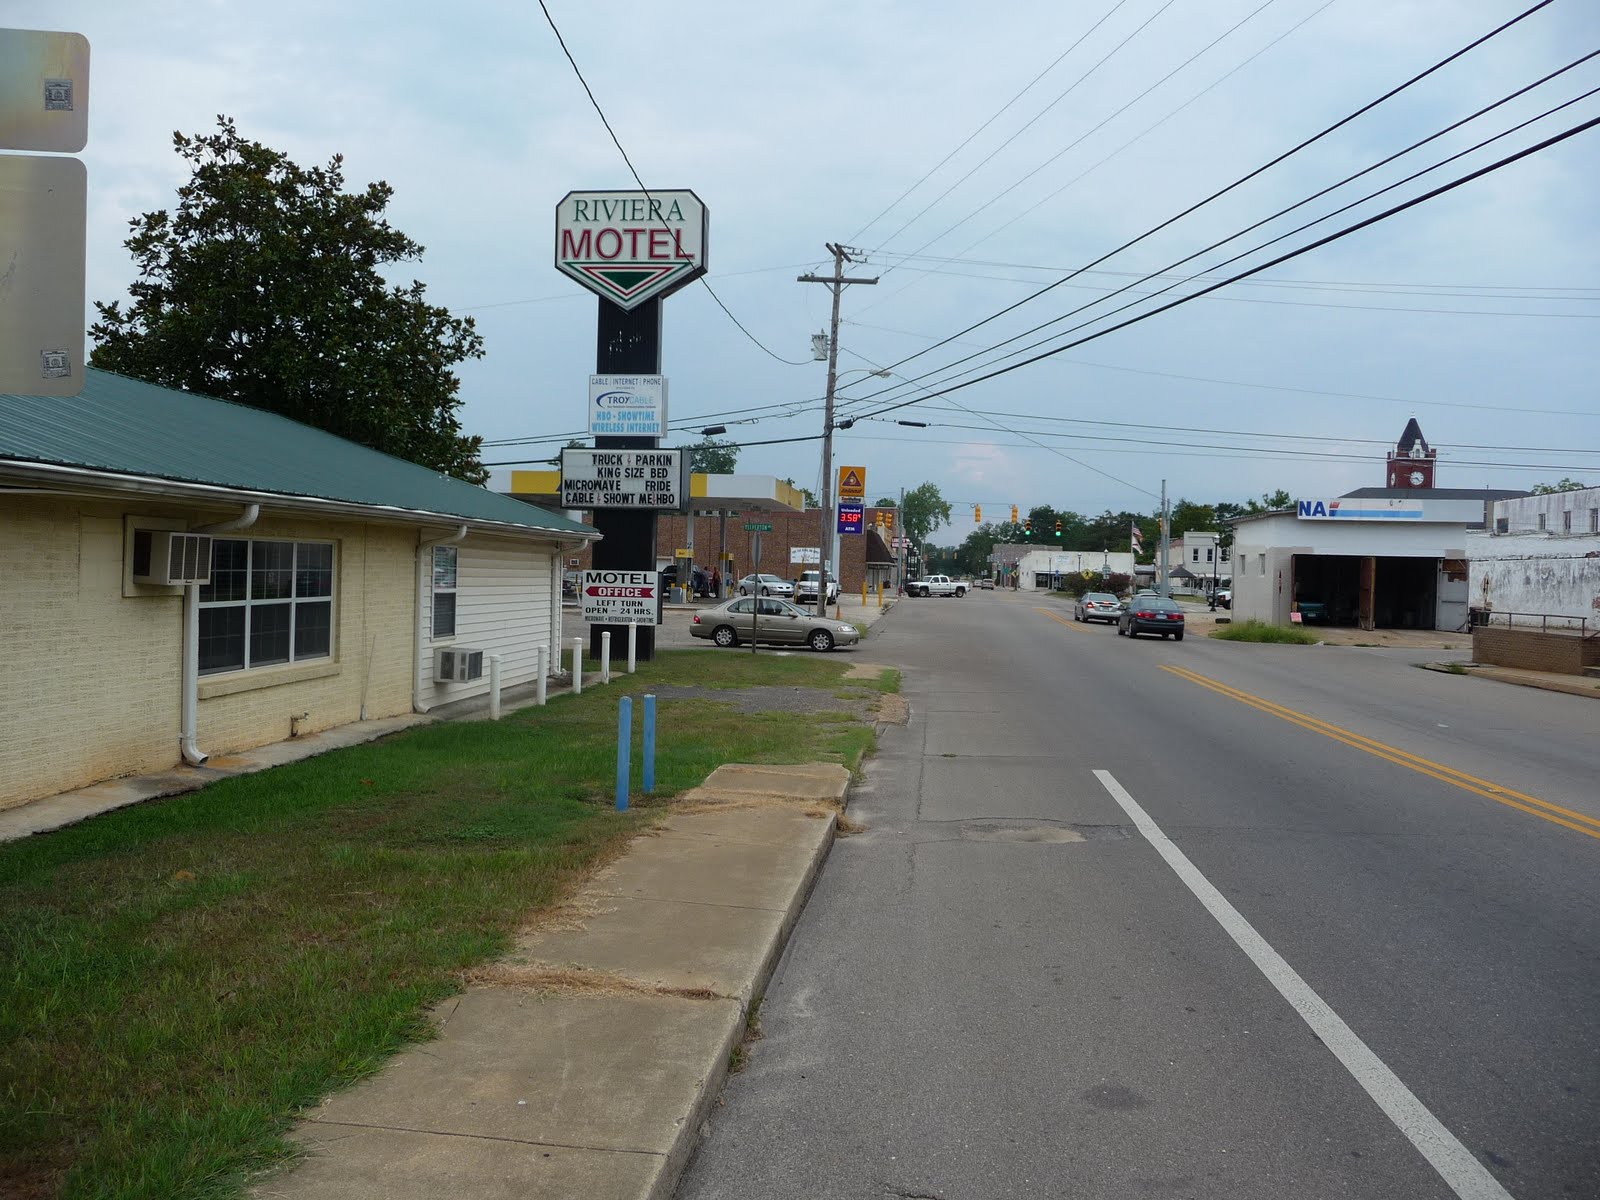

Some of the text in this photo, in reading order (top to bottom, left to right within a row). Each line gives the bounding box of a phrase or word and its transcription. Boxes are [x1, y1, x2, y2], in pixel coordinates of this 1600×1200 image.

[573, 199, 685, 222] RIVIERA
[562, 228, 695, 260] MOTEL
[643, 378, 661, 386] PHONE
[597, 411, 655, 420] HBO SHOWTIME
[592, 423, 659, 432] WIRELESS INTERNET
[592, 454, 672, 466] TRUCK PARKIN
[597, 467, 668, 478] KING SIZE BED
[564, 480, 671, 491] MICROWAVE FRIDE
[565, 492, 675, 504] CABLE SHOWT ME HBO
[586, 572, 654, 584] MOTEL
[598, 587, 642, 597] OFFICE
